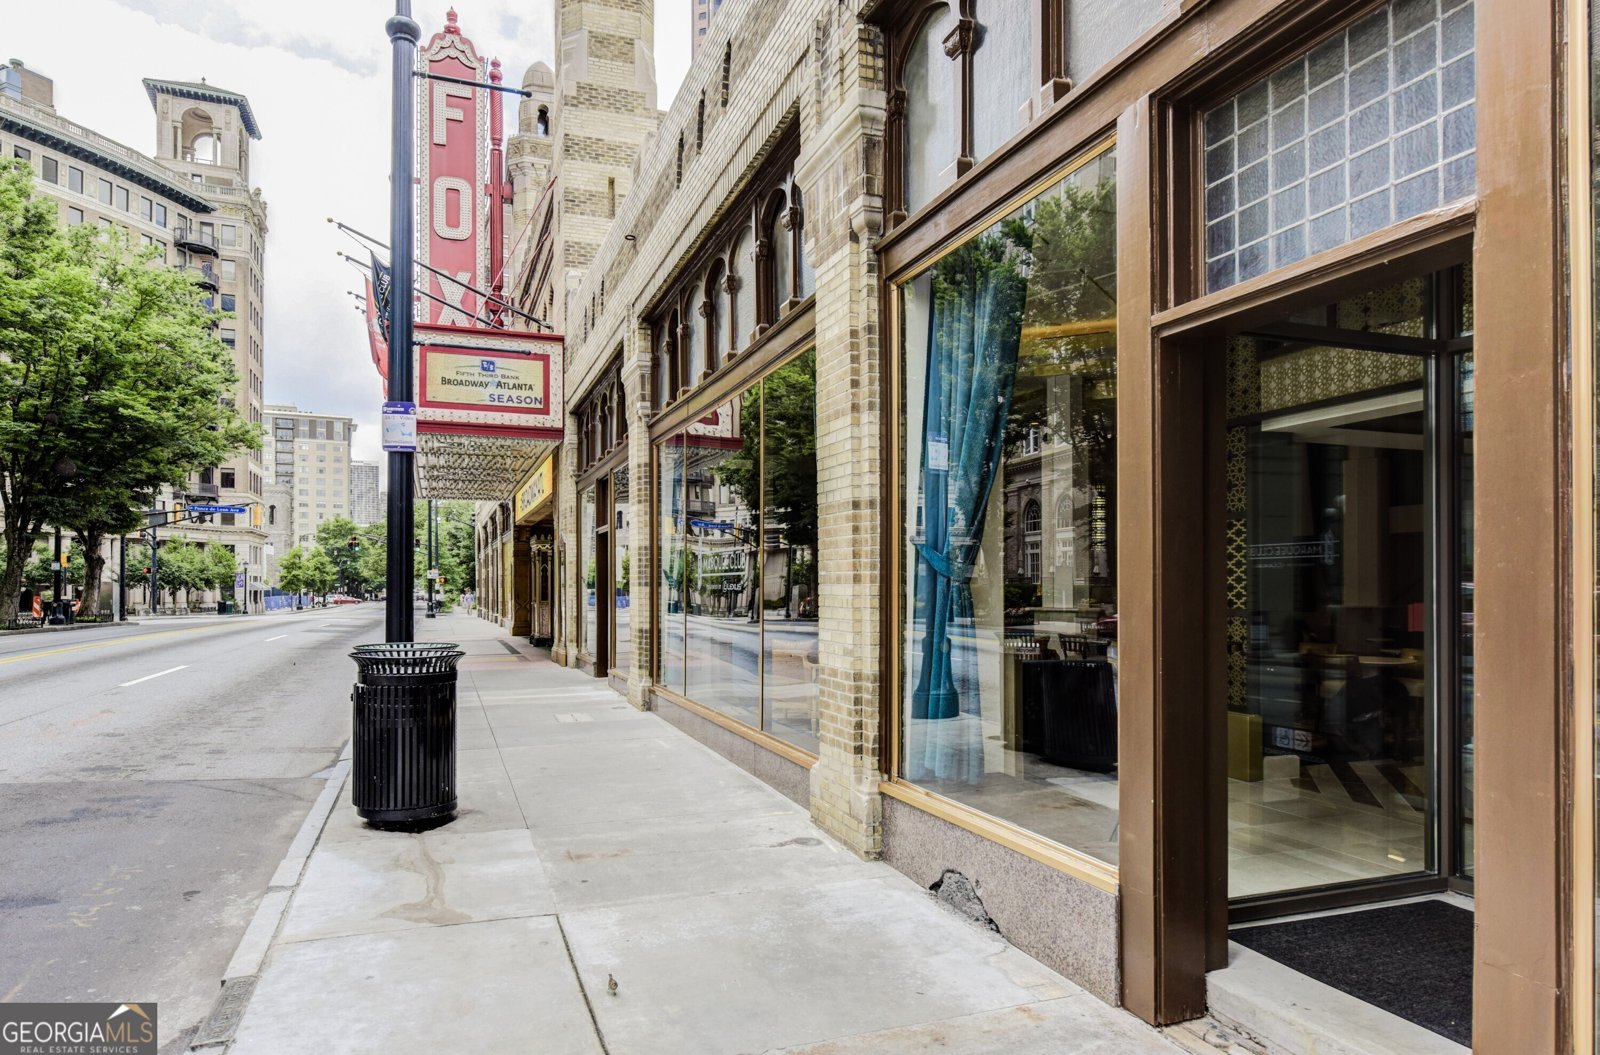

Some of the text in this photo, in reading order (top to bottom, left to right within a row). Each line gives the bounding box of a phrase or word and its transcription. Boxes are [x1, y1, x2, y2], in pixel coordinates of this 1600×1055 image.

[433, 81, 472, 327] FOX
[379, 273, 391, 293] CLUB
[441, 376, 534, 391] BROADWAY ATLANTA
[489, 393, 543, 405] SEASON
[730, 551, 746, 570] CLUB
